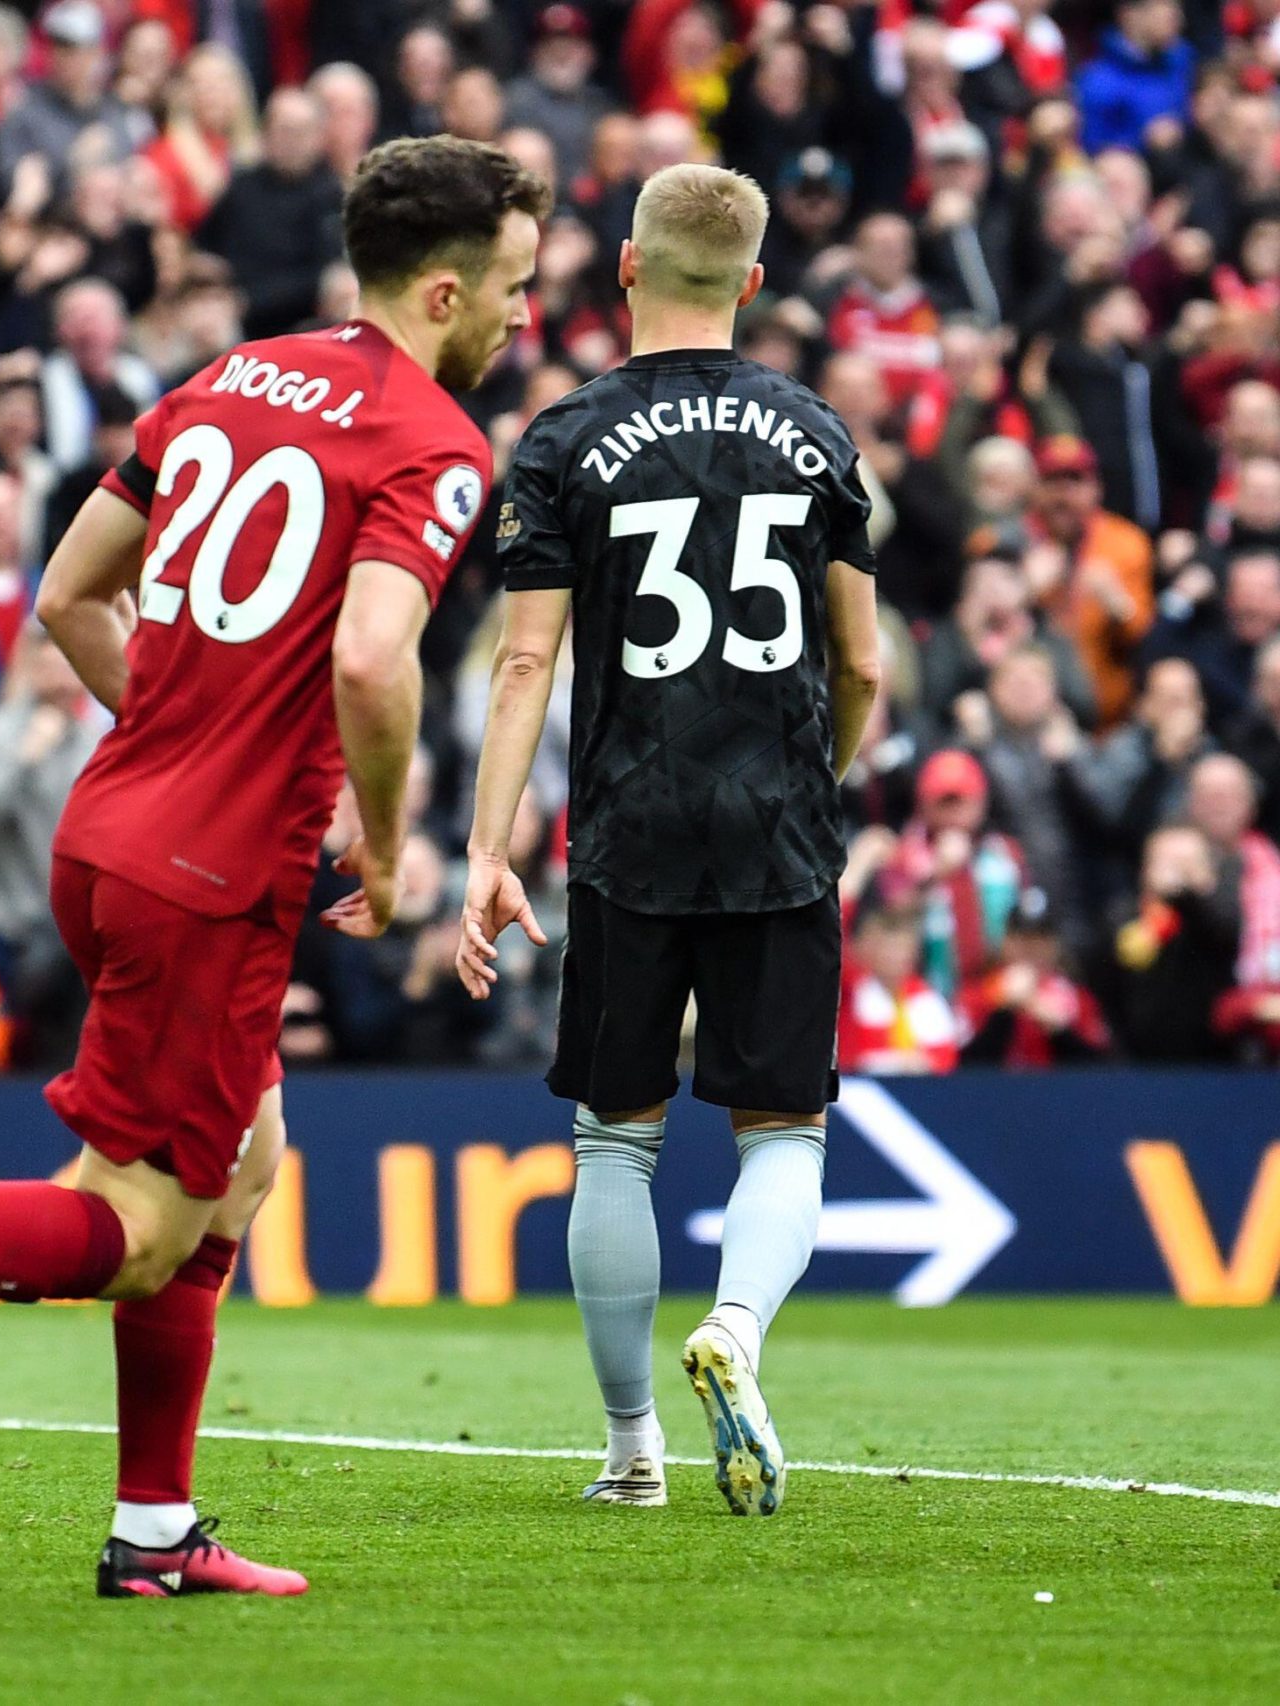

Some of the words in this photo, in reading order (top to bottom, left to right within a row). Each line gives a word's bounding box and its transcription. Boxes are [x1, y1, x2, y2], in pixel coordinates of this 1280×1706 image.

[211, 353, 331, 413] DIOGO
[320, 390, 365, 429] J.
[580, 395, 828, 484] ZINCHENKO
[138, 423, 326, 645] 20
[608, 492, 814, 680] 35
